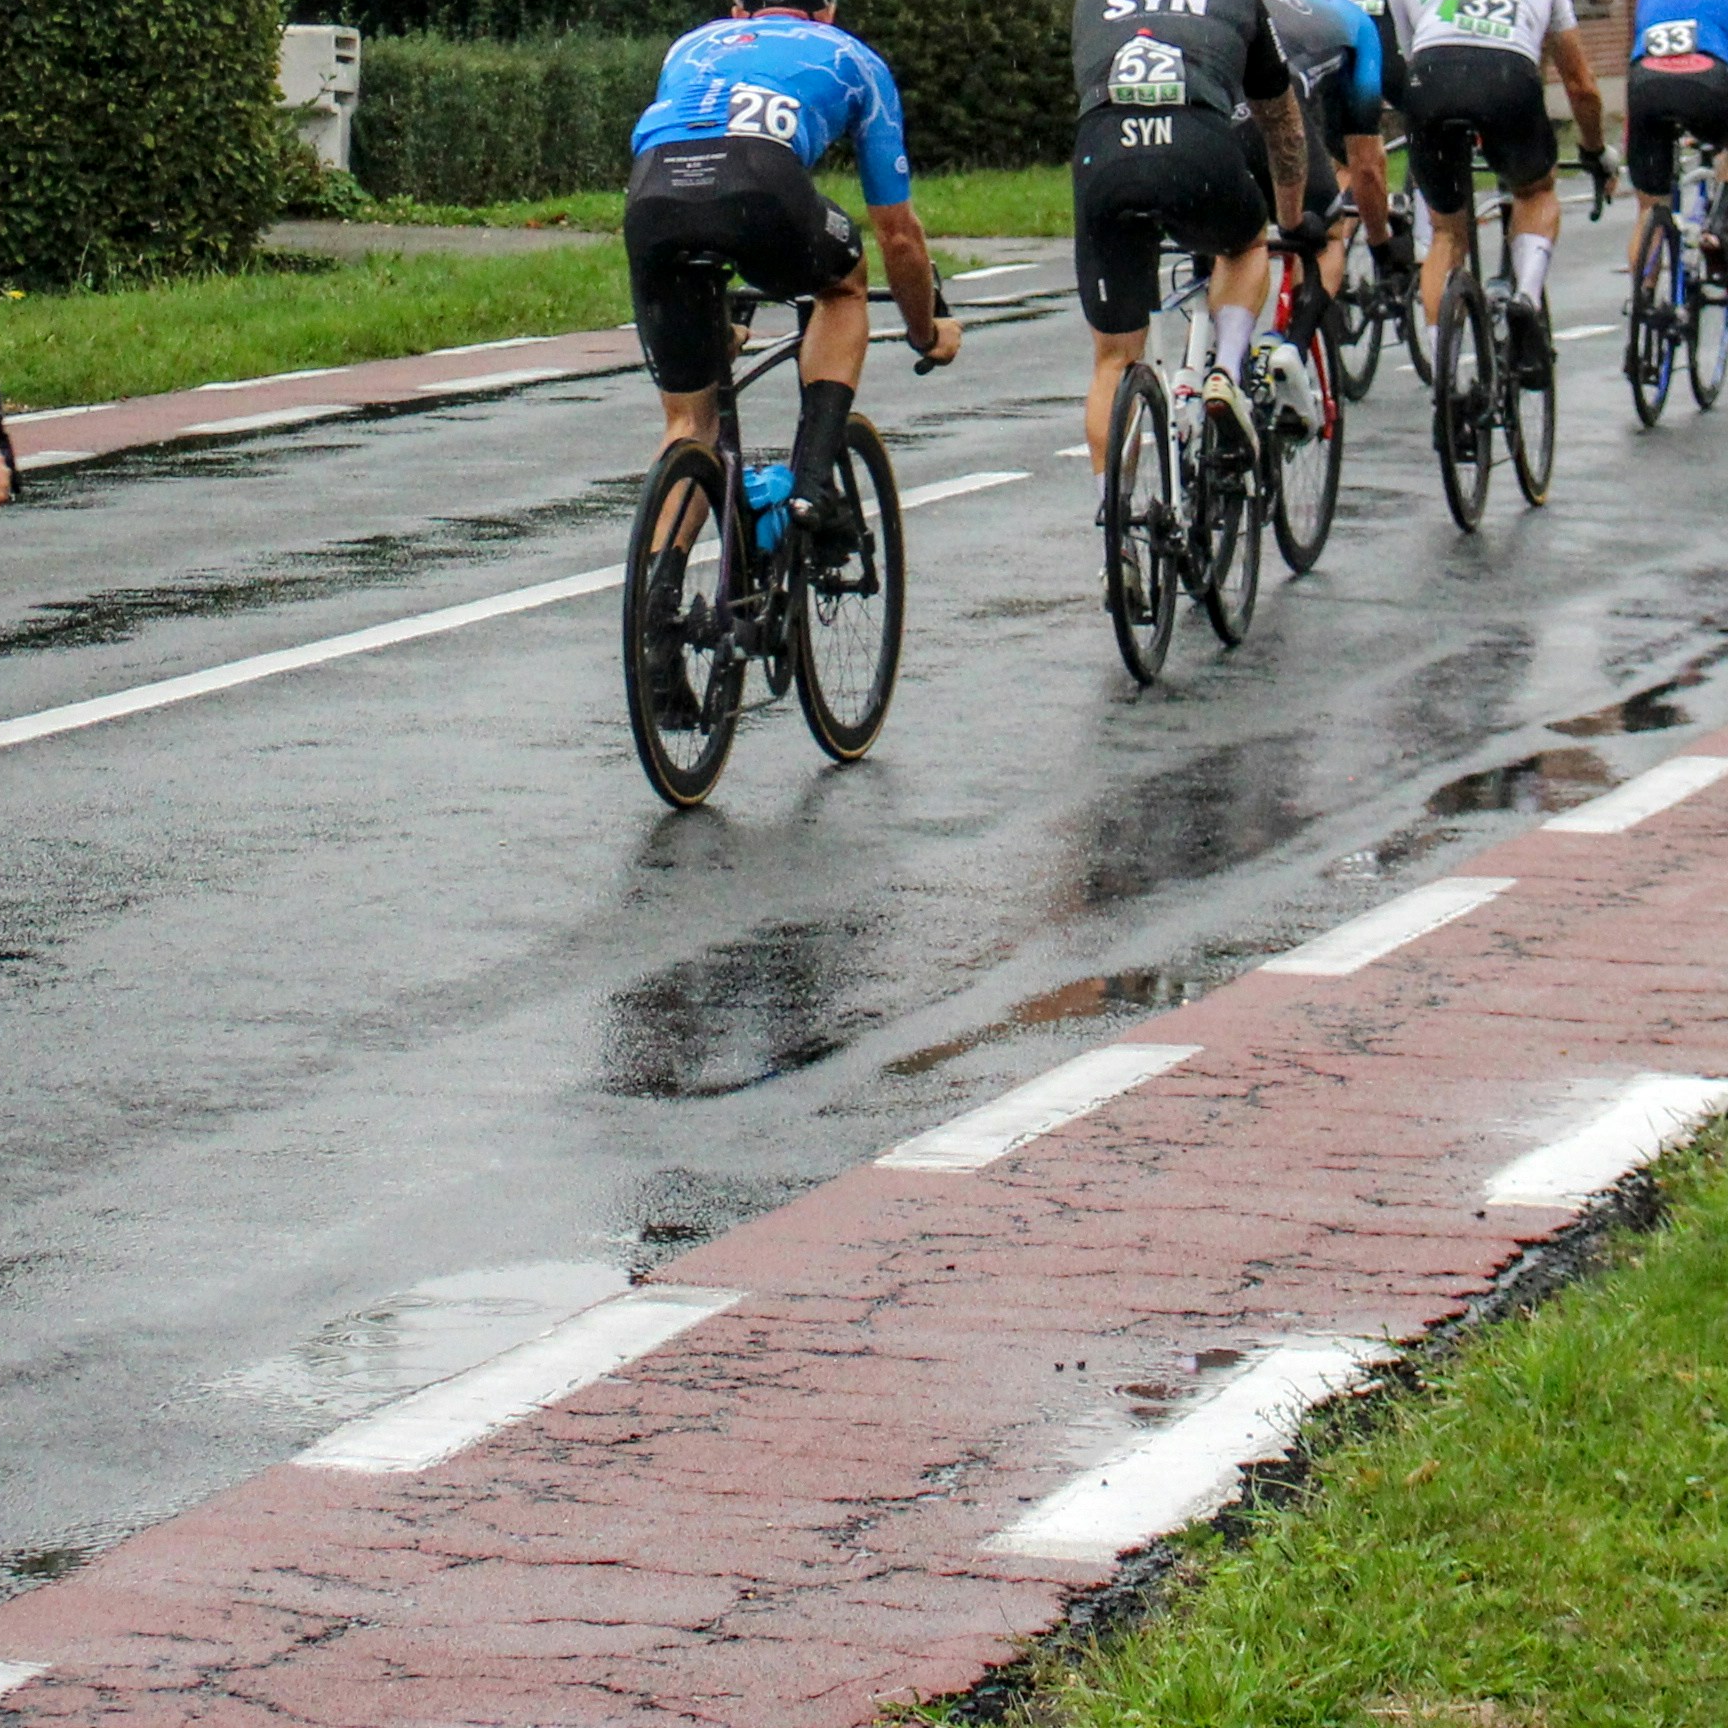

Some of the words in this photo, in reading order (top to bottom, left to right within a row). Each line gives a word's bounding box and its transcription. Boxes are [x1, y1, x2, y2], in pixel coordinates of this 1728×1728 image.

[1647, 27, 1693, 56] 33
[1118, 47, 1177, 83] 52
[728, 92, 801, 140] 26
[1120, 116, 1173, 147] SYN
